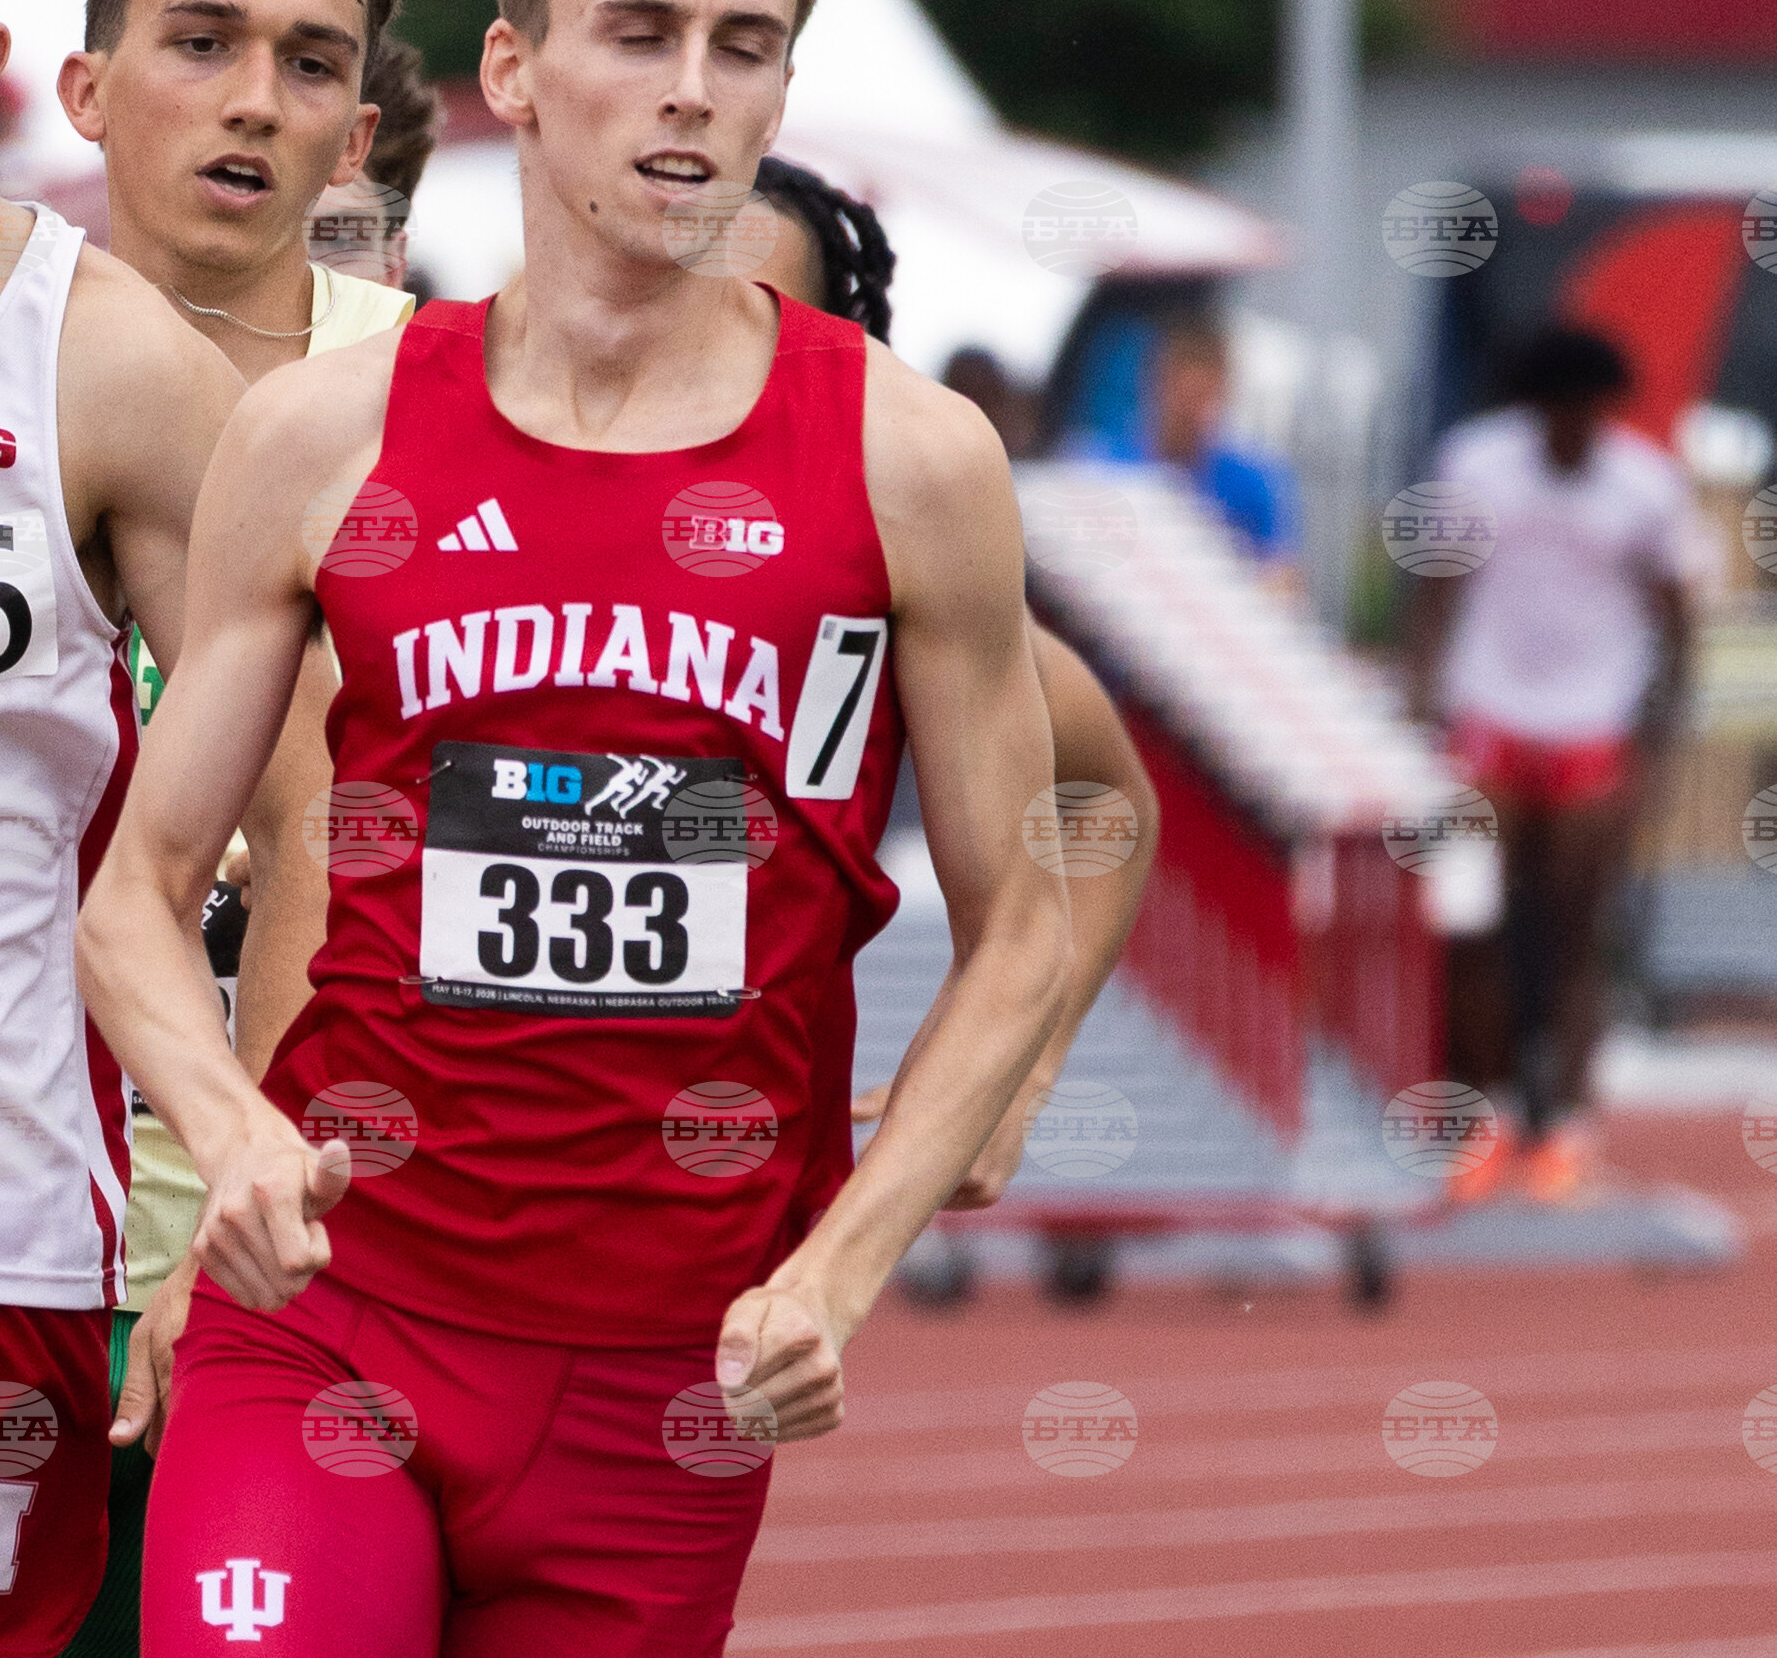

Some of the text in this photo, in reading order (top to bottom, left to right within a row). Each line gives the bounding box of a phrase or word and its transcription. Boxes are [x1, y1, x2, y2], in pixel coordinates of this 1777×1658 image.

[393, 602, 786, 742] INDIANA
[805, 630, 881, 787] 7
[522, 816, 644, 836] OUTDOOR TRACK
[546, 831, 622, 847] AND FIELD
[537, 843, 630, 857] CHAMPIONSHIPS
[477, 863, 689, 985] 333
[547, 995, 597, 1007] NEBRASKA
[604, 997, 655, 1008] NEBRASKA
